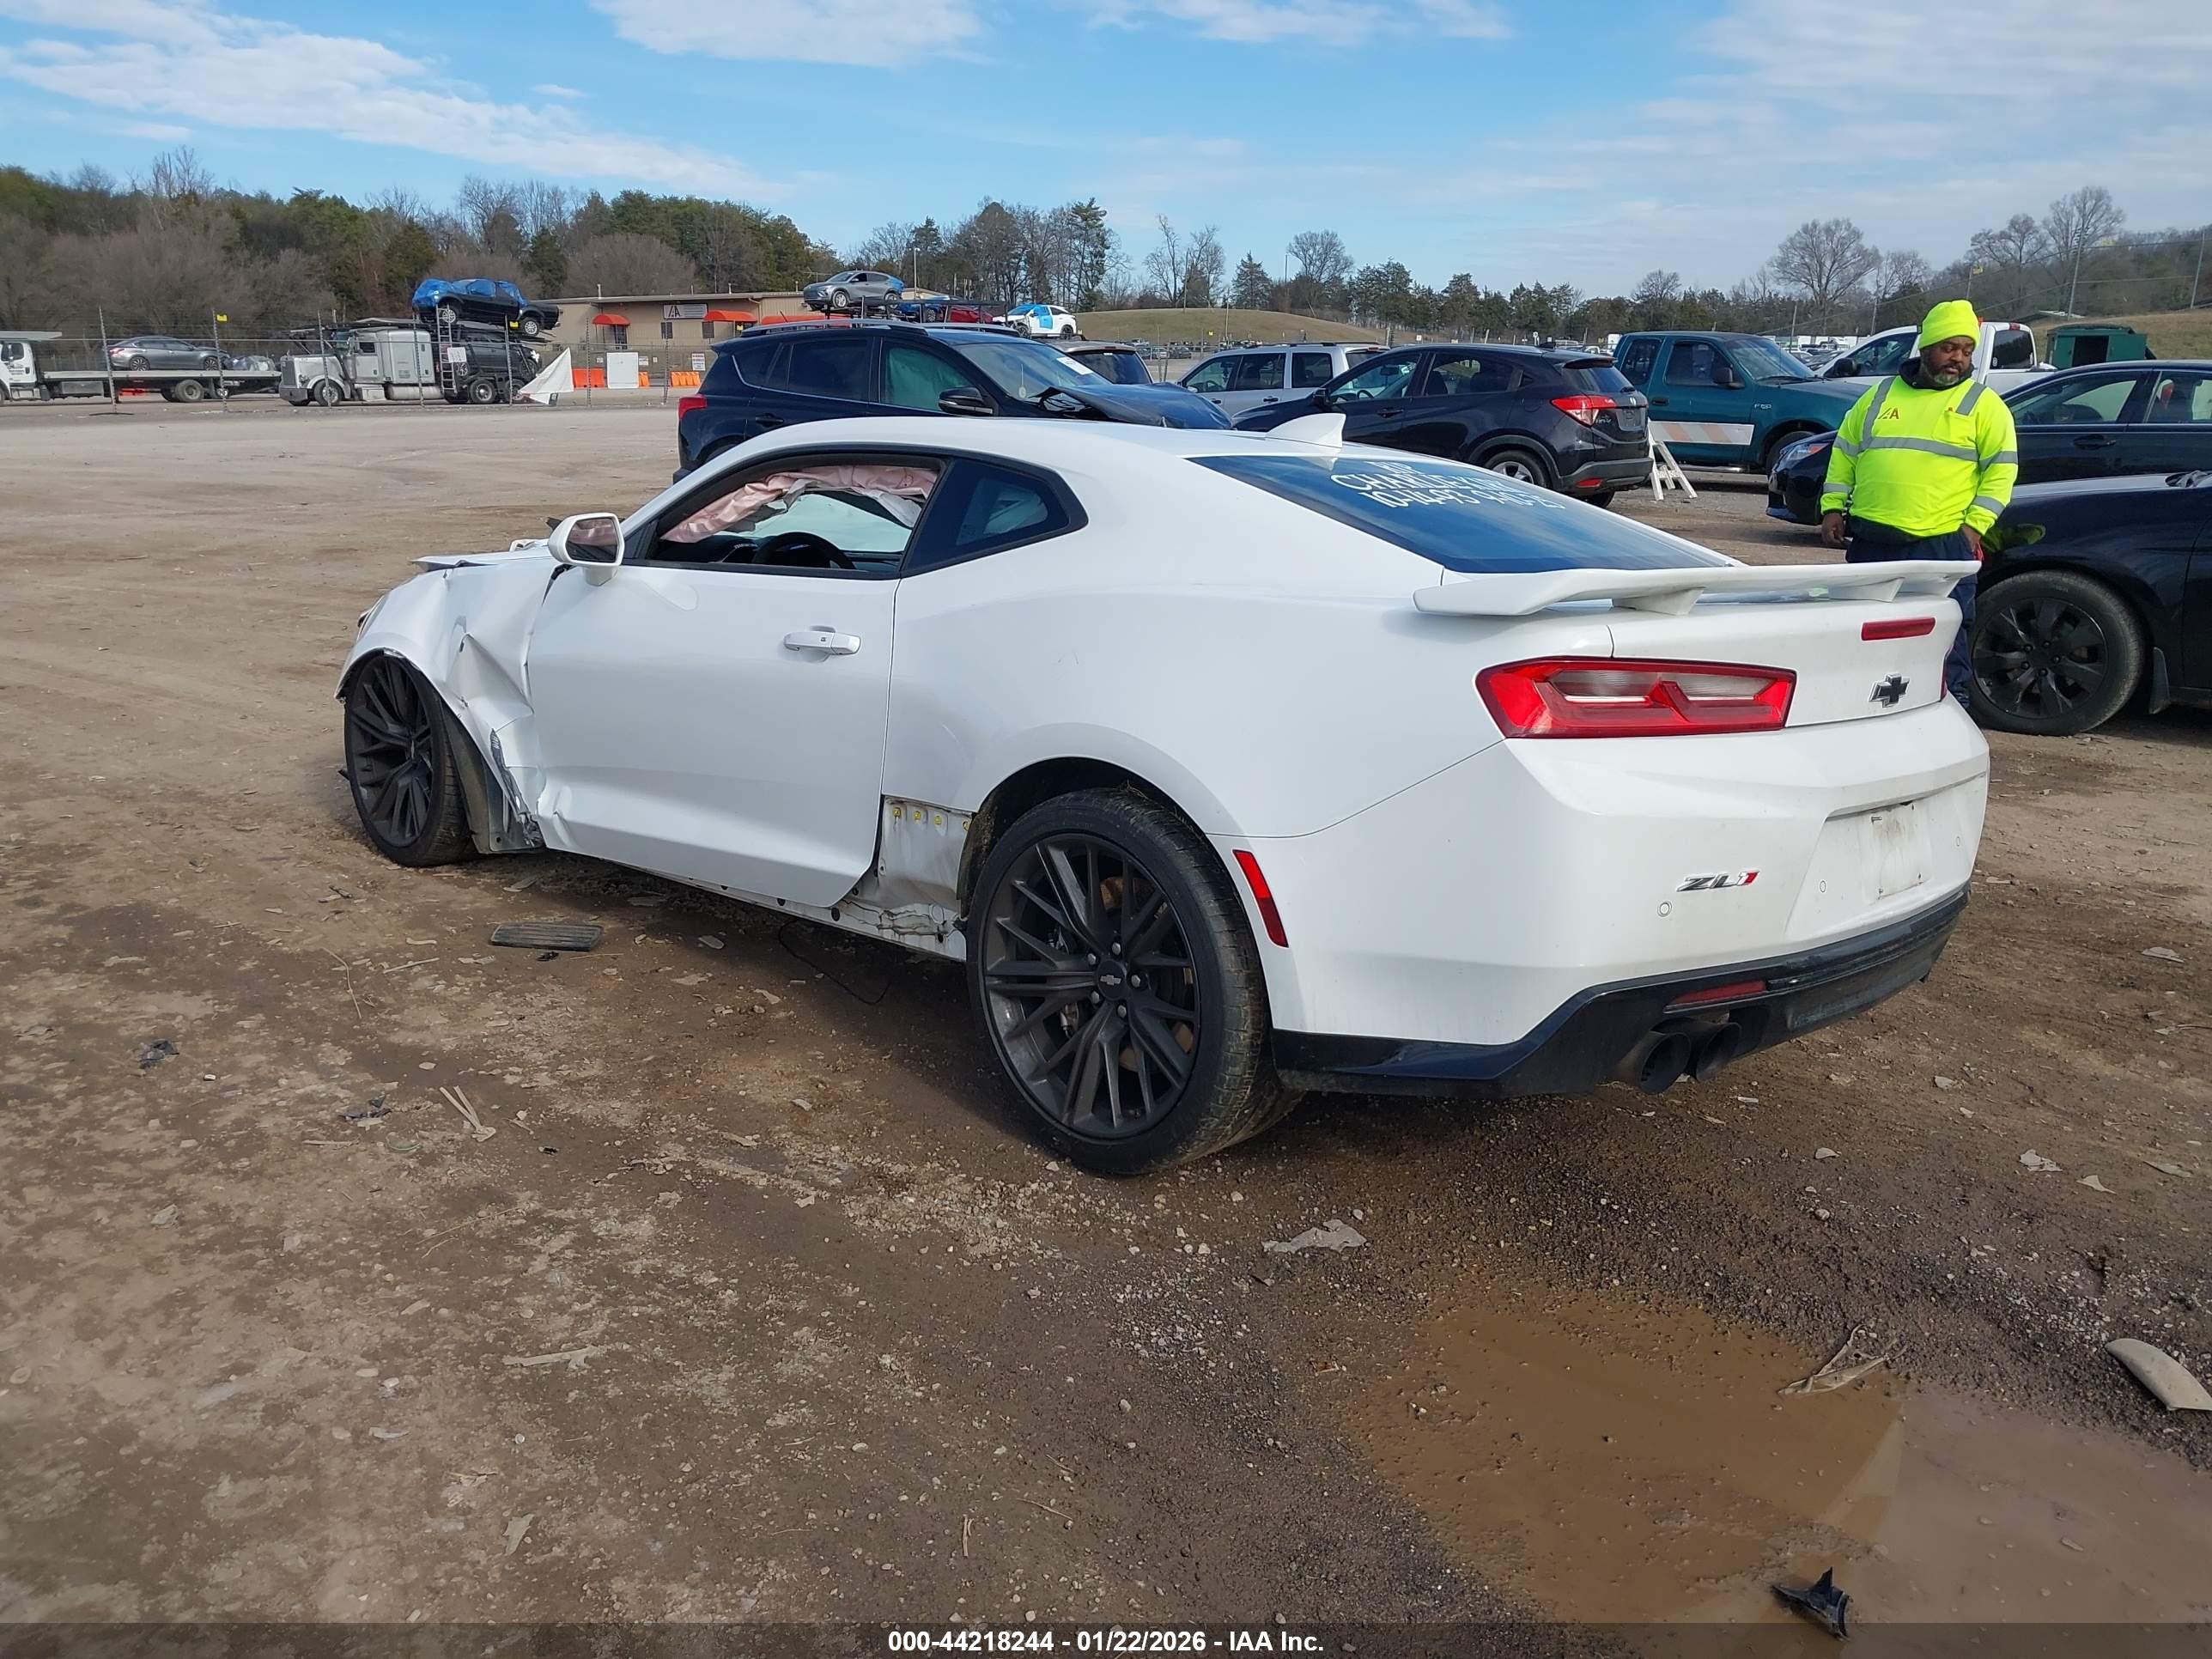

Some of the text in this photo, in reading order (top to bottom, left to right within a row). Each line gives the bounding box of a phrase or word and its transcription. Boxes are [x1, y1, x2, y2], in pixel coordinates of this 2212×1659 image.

[1364, 461, 1424, 474] RIP
[1330, 473, 1529, 494] CHARLIE KIRK
[1357, 488, 1567, 509] 10-14-93 9-10-25
[1676, 868, 1761, 892] ZL1
